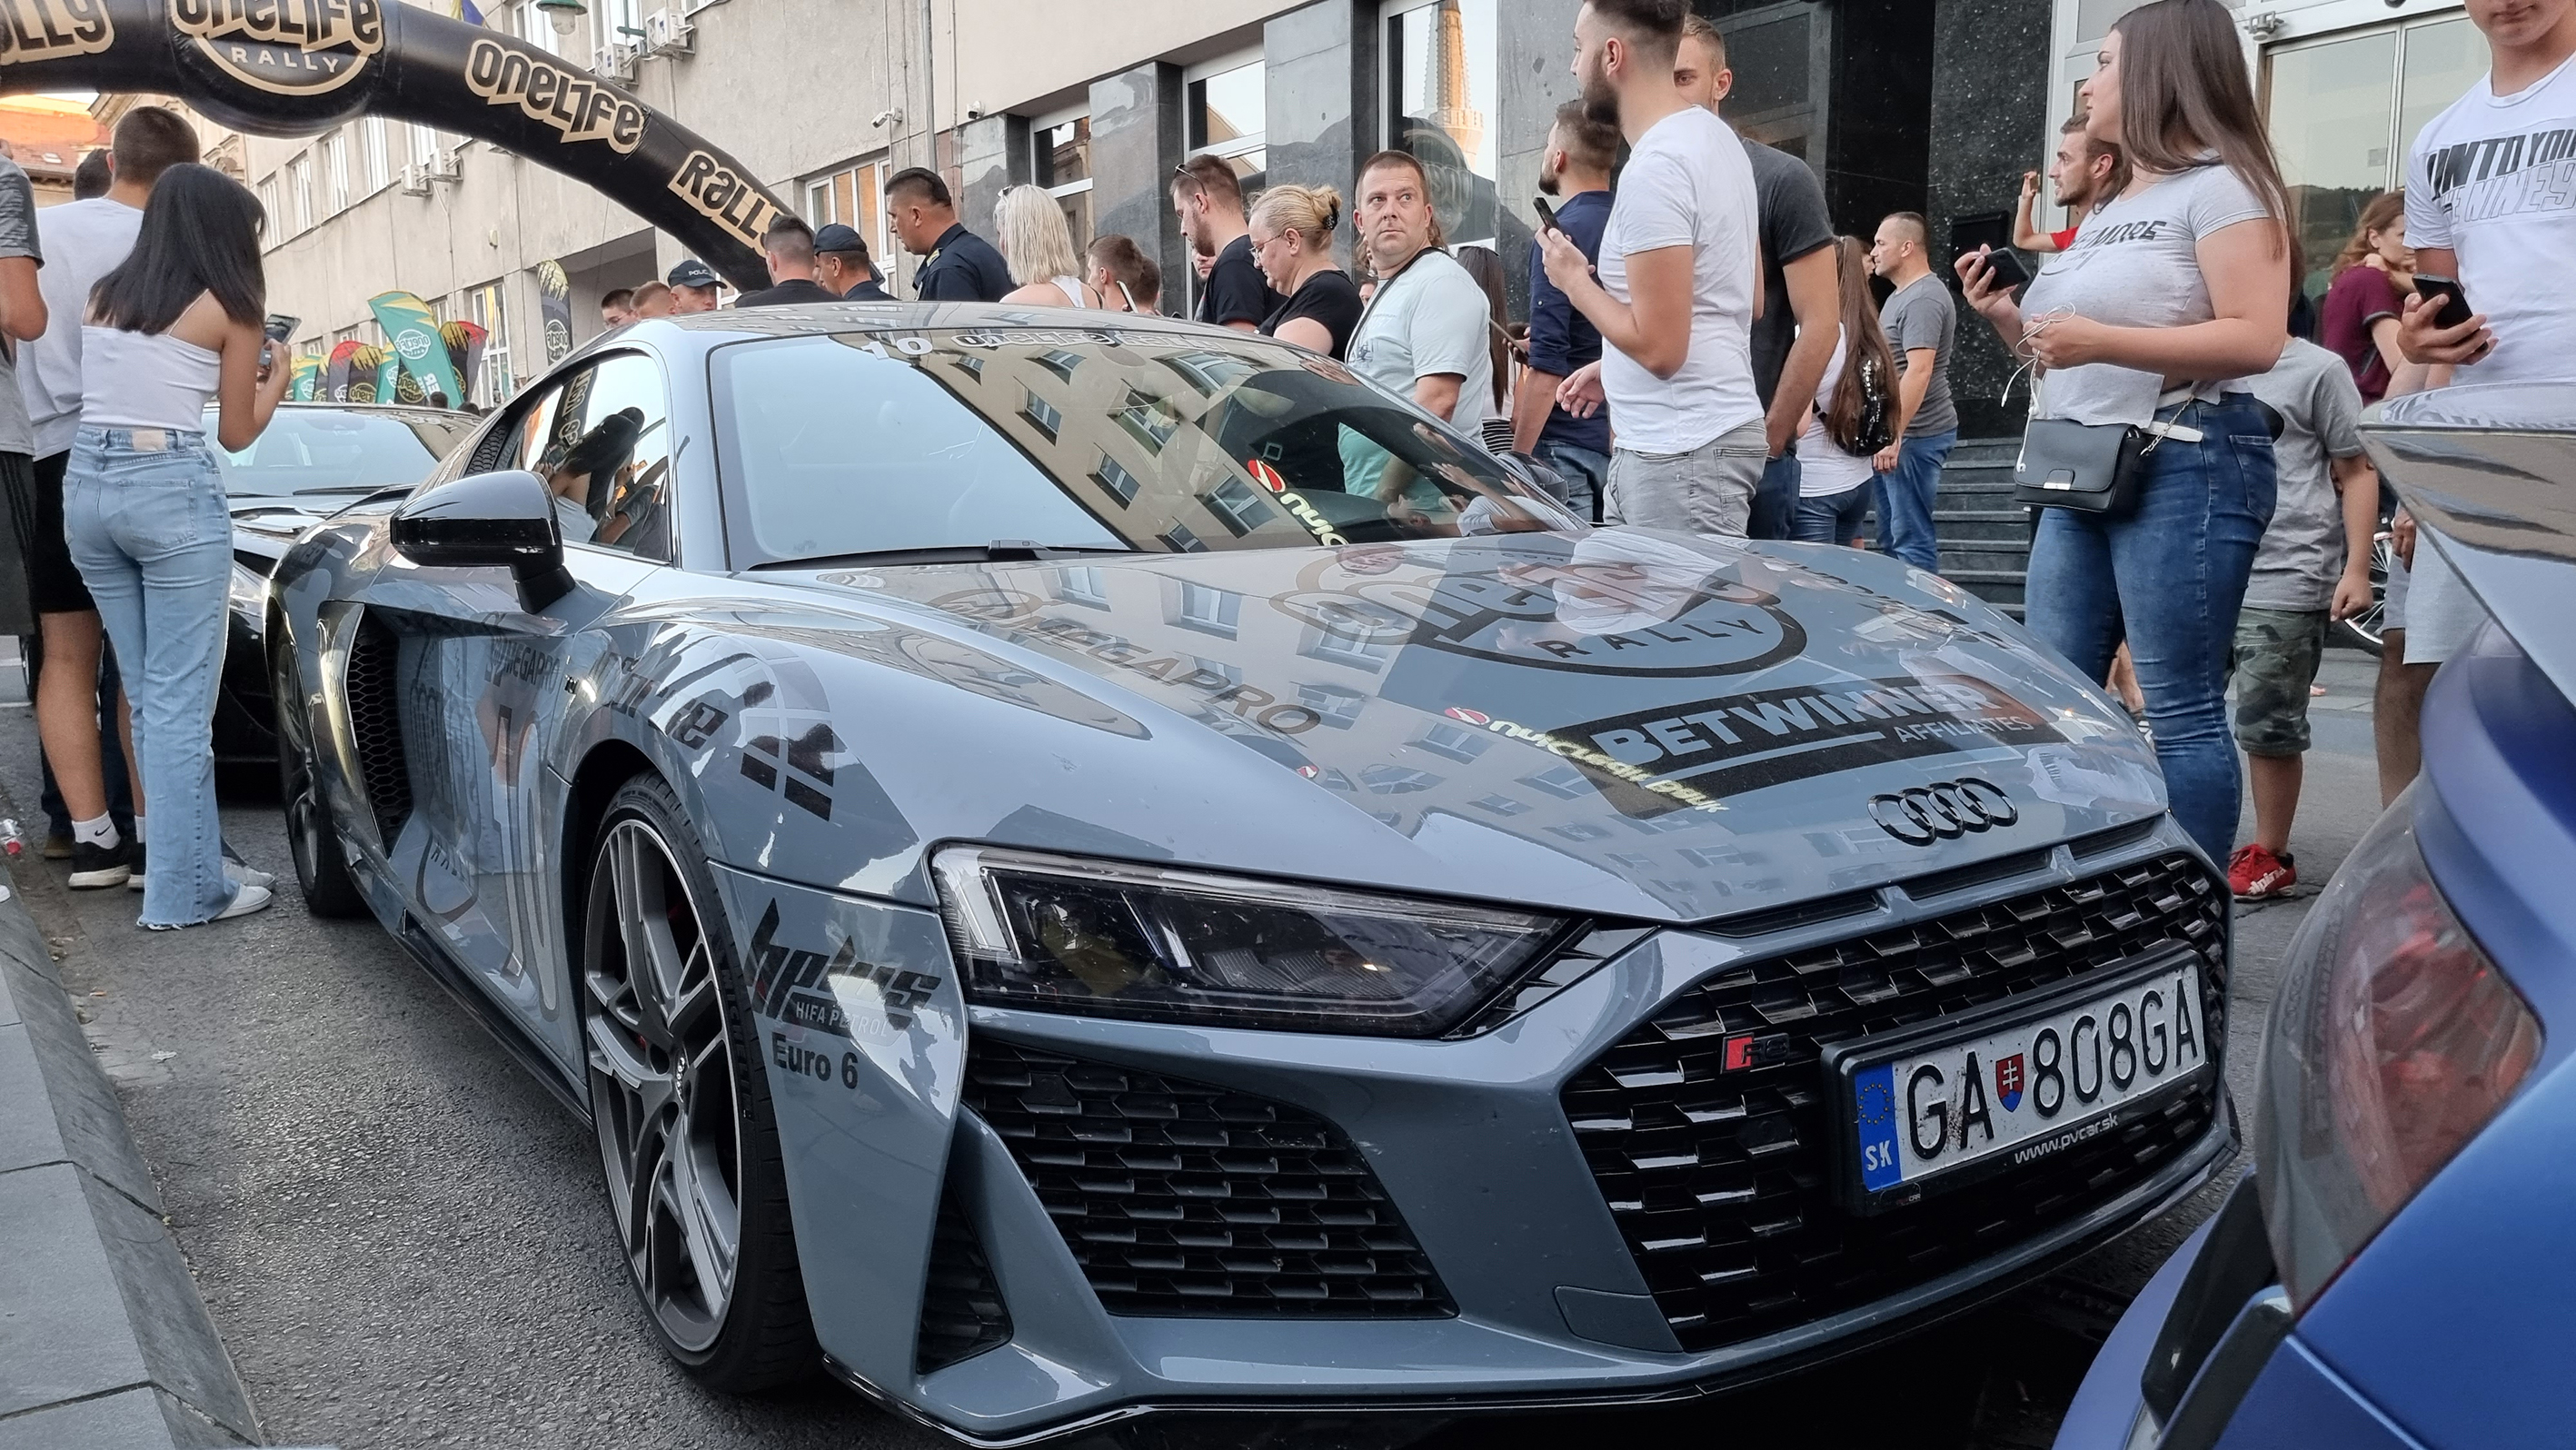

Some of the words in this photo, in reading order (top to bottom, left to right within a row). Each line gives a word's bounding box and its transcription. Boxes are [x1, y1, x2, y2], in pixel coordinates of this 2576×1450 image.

[230, 46, 340, 74] RALLY
[860, 336, 933, 361] 10
[1535, 618, 1765, 659] RALLY
[1590, 683, 2003, 767] BETWINNER
[1895, 716, 2036, 743] AFFILIATES
[795, 1001, 825, 1024] HIFA
[829, 1006, 888, 1038] PETROL
[771, 1031, 831, 1082] Euro
[841, 1052, 859, 1089] 6
[1906, 1050, 1994, 1159] GA
[2032, 978, 2201, 1118] 808GA
[1865, 1139, 1893, 1172] SK
[2014, 1114, 2118, 1166] www.pvcar.sk
